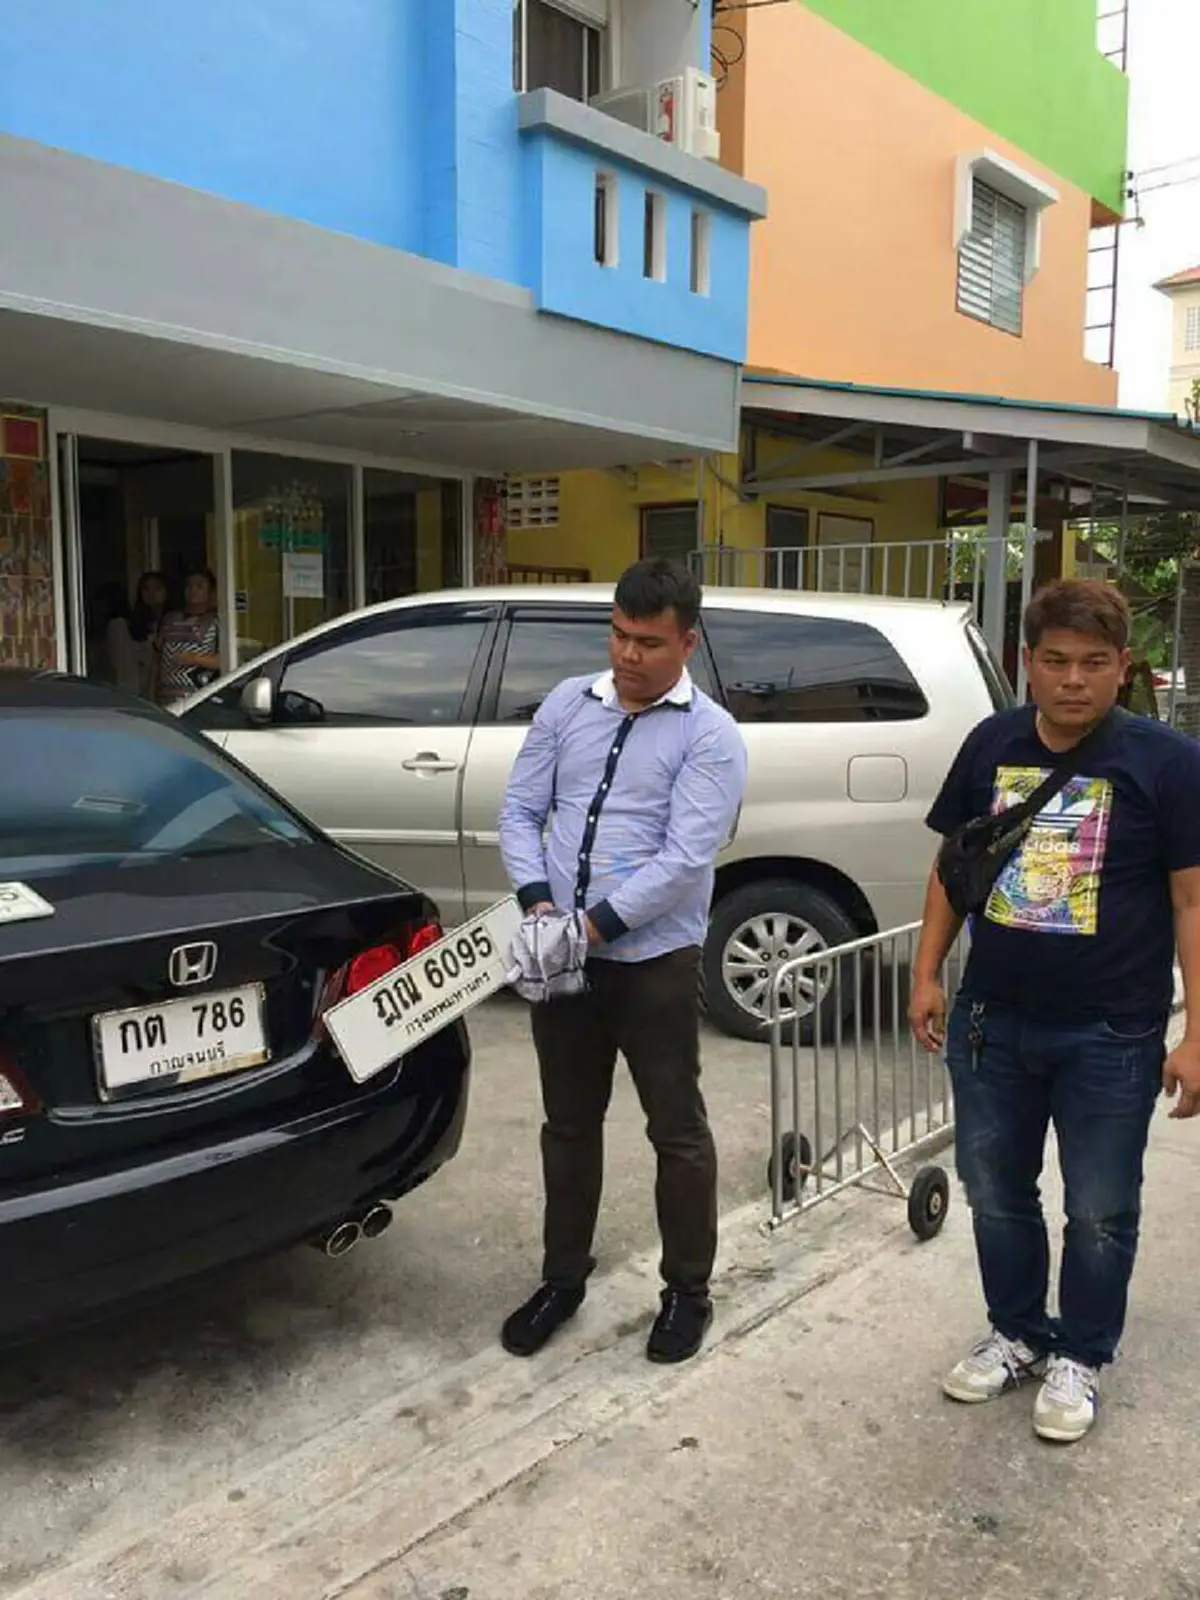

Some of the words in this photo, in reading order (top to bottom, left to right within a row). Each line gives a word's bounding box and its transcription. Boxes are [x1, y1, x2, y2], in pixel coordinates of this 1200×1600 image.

[424, 926, 492, 988] 6095
[192, 997, 245, 1038] 786
[405, 971, 491, 1036] กรุงเทพมหานคร
[150, 1041, 226, 1074] กาญจนบรี
